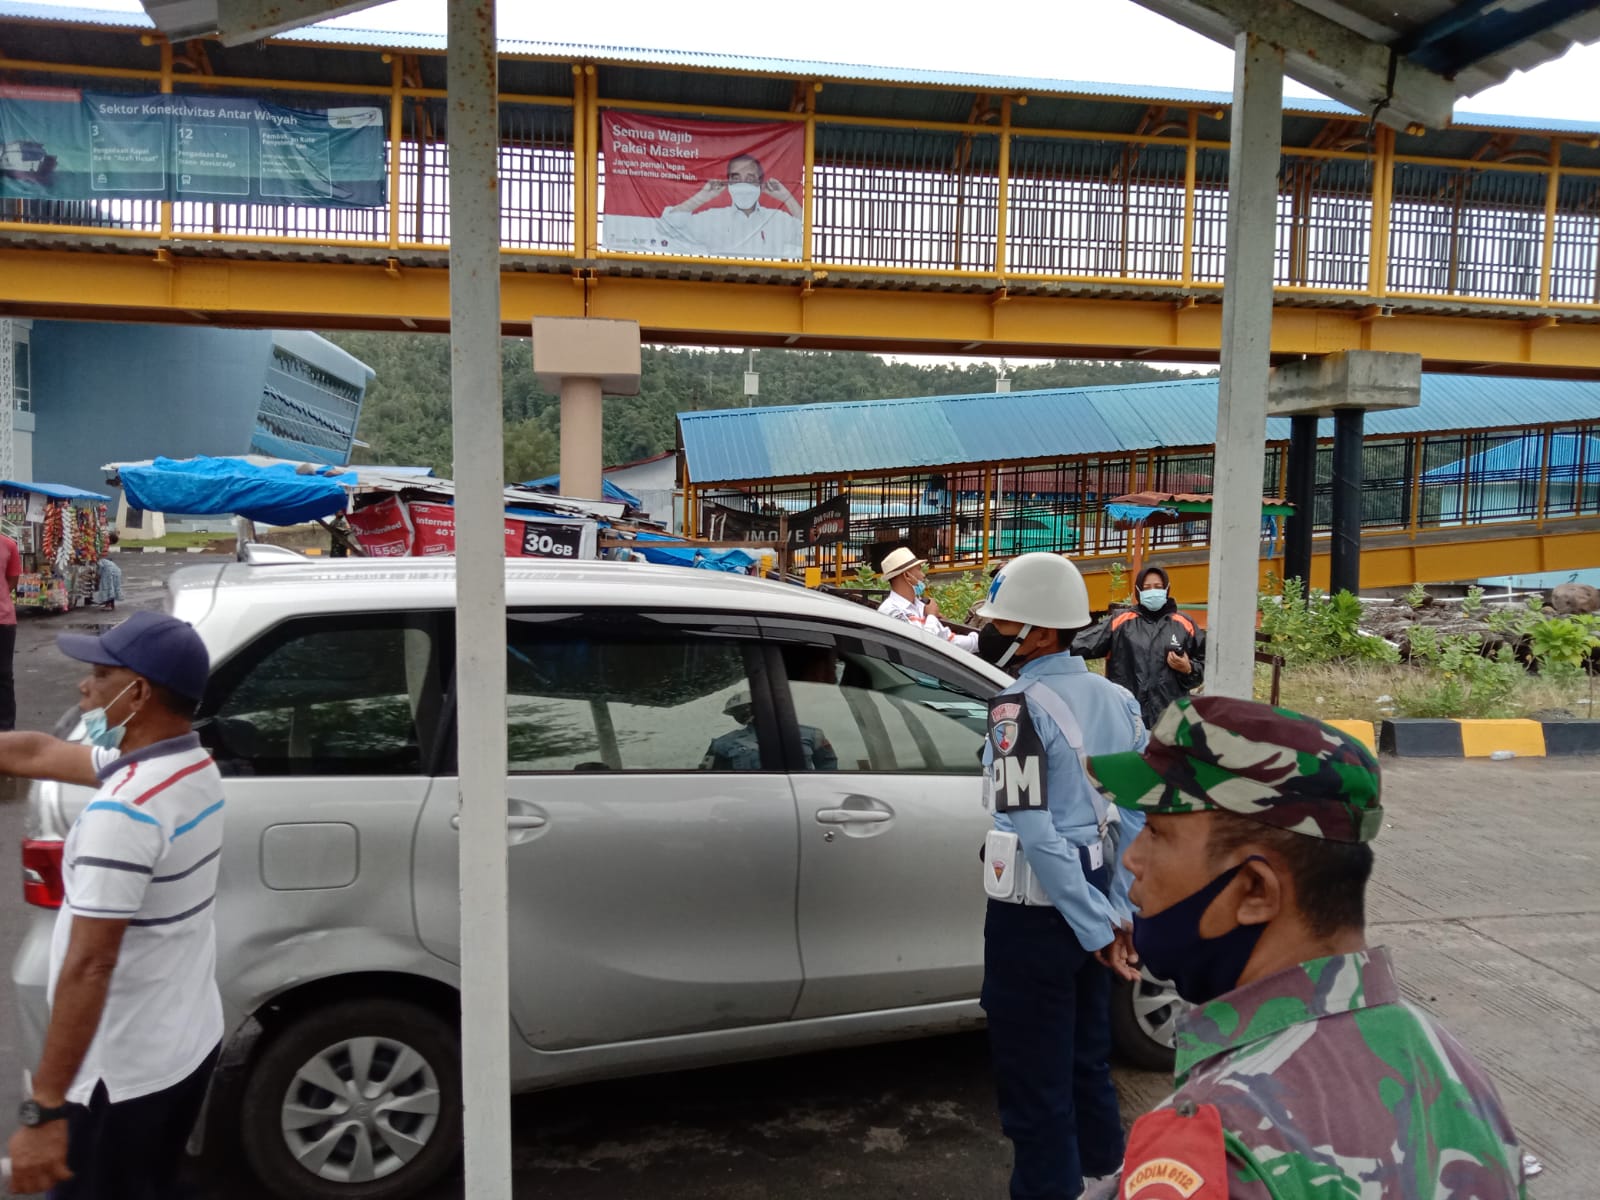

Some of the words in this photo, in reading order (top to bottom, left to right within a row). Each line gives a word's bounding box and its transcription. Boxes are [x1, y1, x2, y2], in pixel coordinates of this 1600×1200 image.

[99, 103, 139, 115] Sektor
[142, 104, 216, 118] Konektivitas
[218, 108, 252, 119] Antar
[91, 124, 99, 137] 3
[178, 127, 193, 140] 12
[612, 124, 655, 140] Semua
[658, 129, 692, 145] Wajib
[613, 141, 647, 155] Pakai
[650, 144, 699, 159] Masker!
[416, 517, 452, 528] Internet
[524, 533, 573, 556] 30GB
[993, 755, 1042, 806] PM
[1128, 1165, 1168, 1191] KODIM
[1168, 1166, 1195, 1191] 0112
